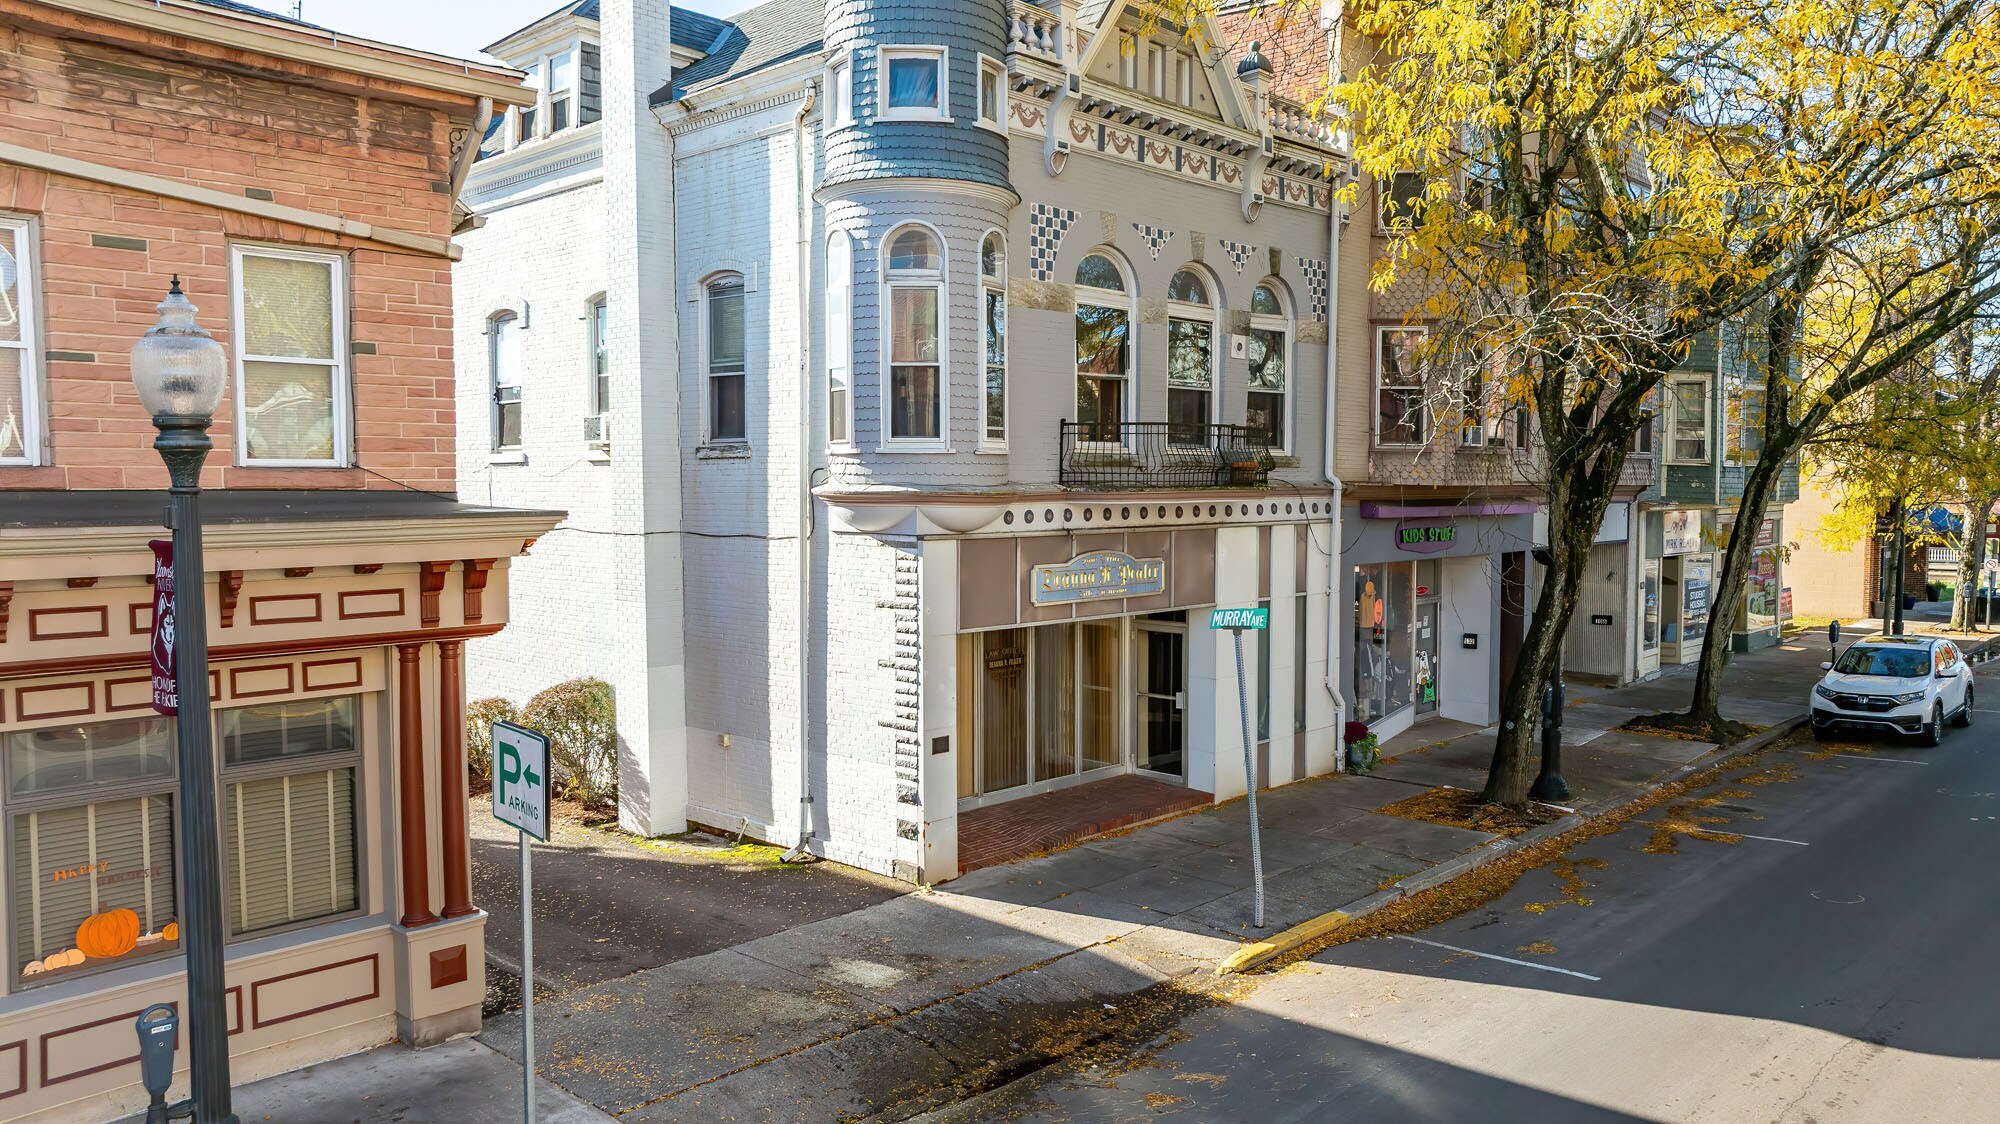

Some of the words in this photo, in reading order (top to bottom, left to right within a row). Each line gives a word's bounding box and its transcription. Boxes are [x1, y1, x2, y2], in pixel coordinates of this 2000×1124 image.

[1402, 528, 1425, 543] KIDS
[1042, 569, 1095, 591] Deanna
[1118, 563, 1159, 586] Pealer
[1690, 590, 1706, 600] STUDENT
[1690, 600, 1706, 609] HOUSING
[1212, 610, 1254, 627] MURRAY
[1250, 615, 1265, 627] AVE
[54, 860, 110, 881] HAPPY
